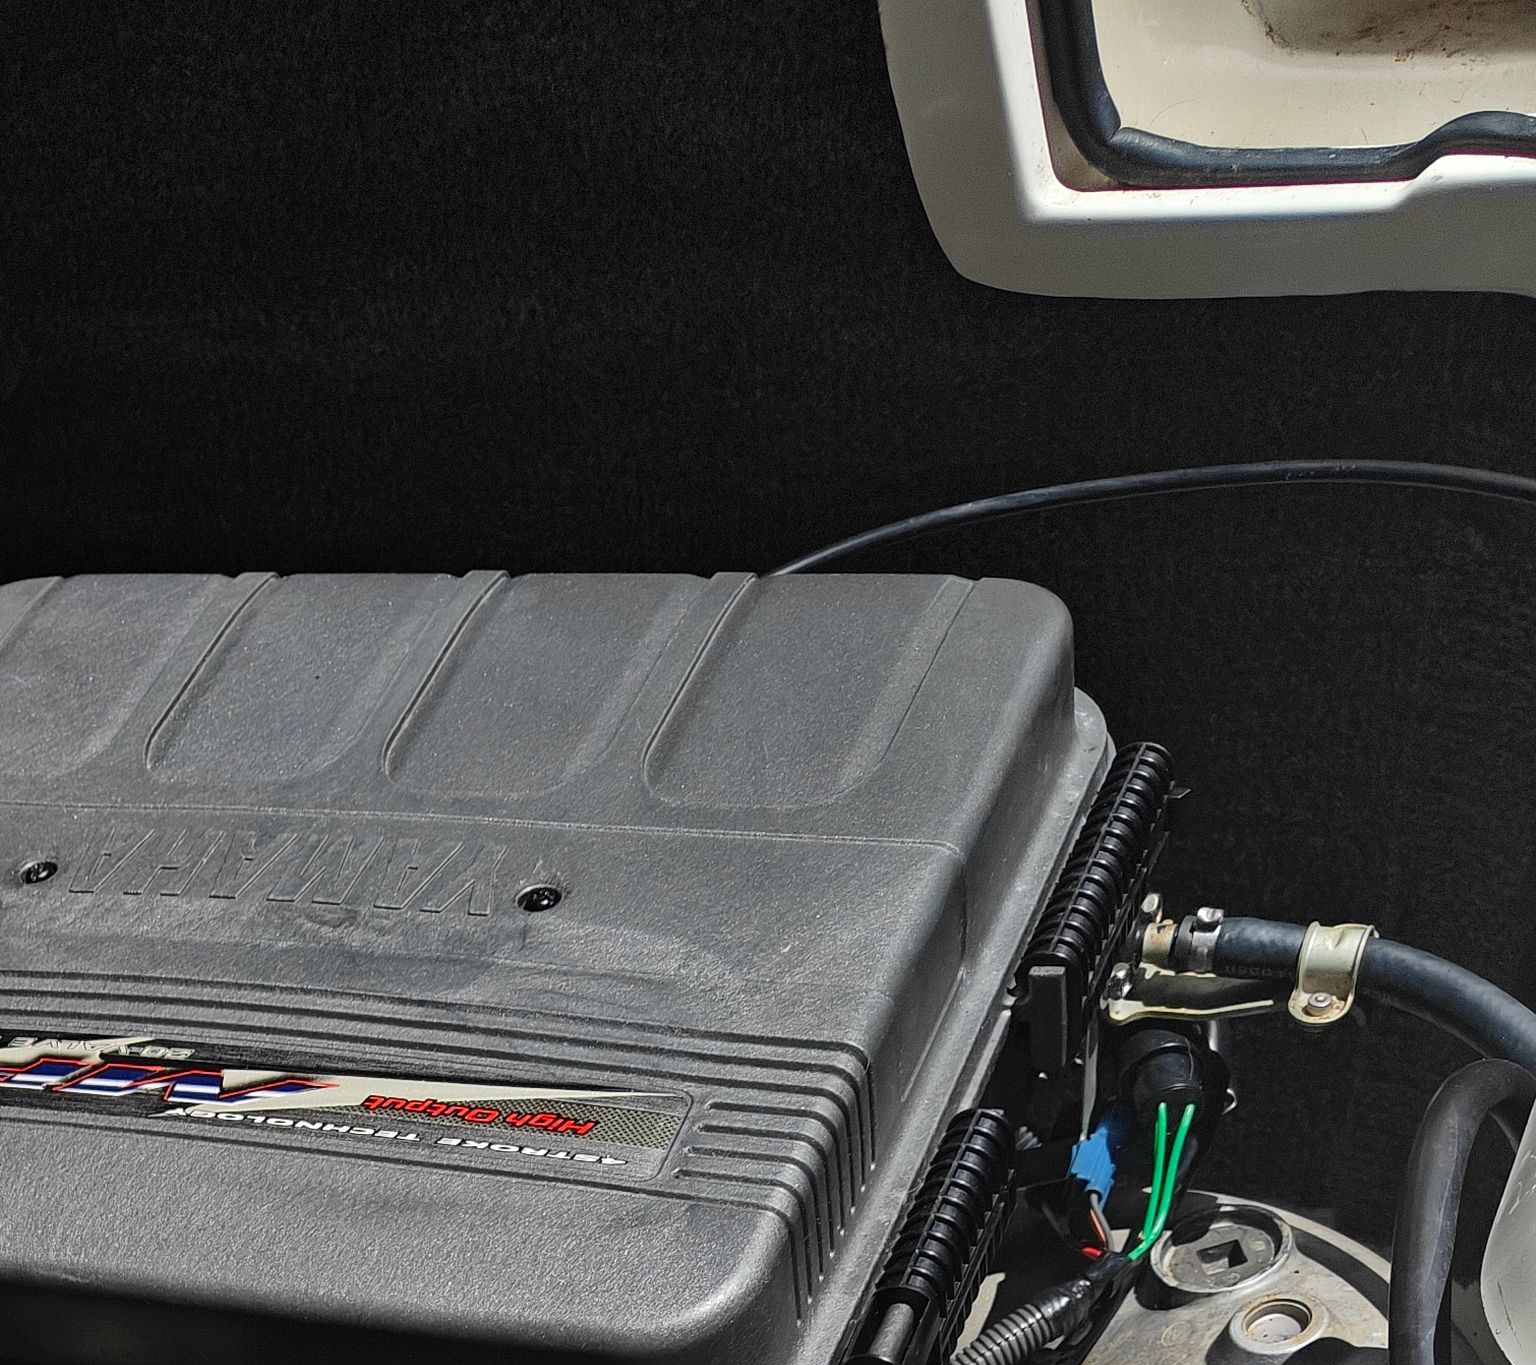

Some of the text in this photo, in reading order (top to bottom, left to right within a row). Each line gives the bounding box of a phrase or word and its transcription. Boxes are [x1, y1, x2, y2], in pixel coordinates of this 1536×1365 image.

[68, 828, 510, 917] YAMAHA
[172, 1106, 628, 1166] 4STROKE TECHNOLOGY
[362, 1094, 596, 1137] High Output
